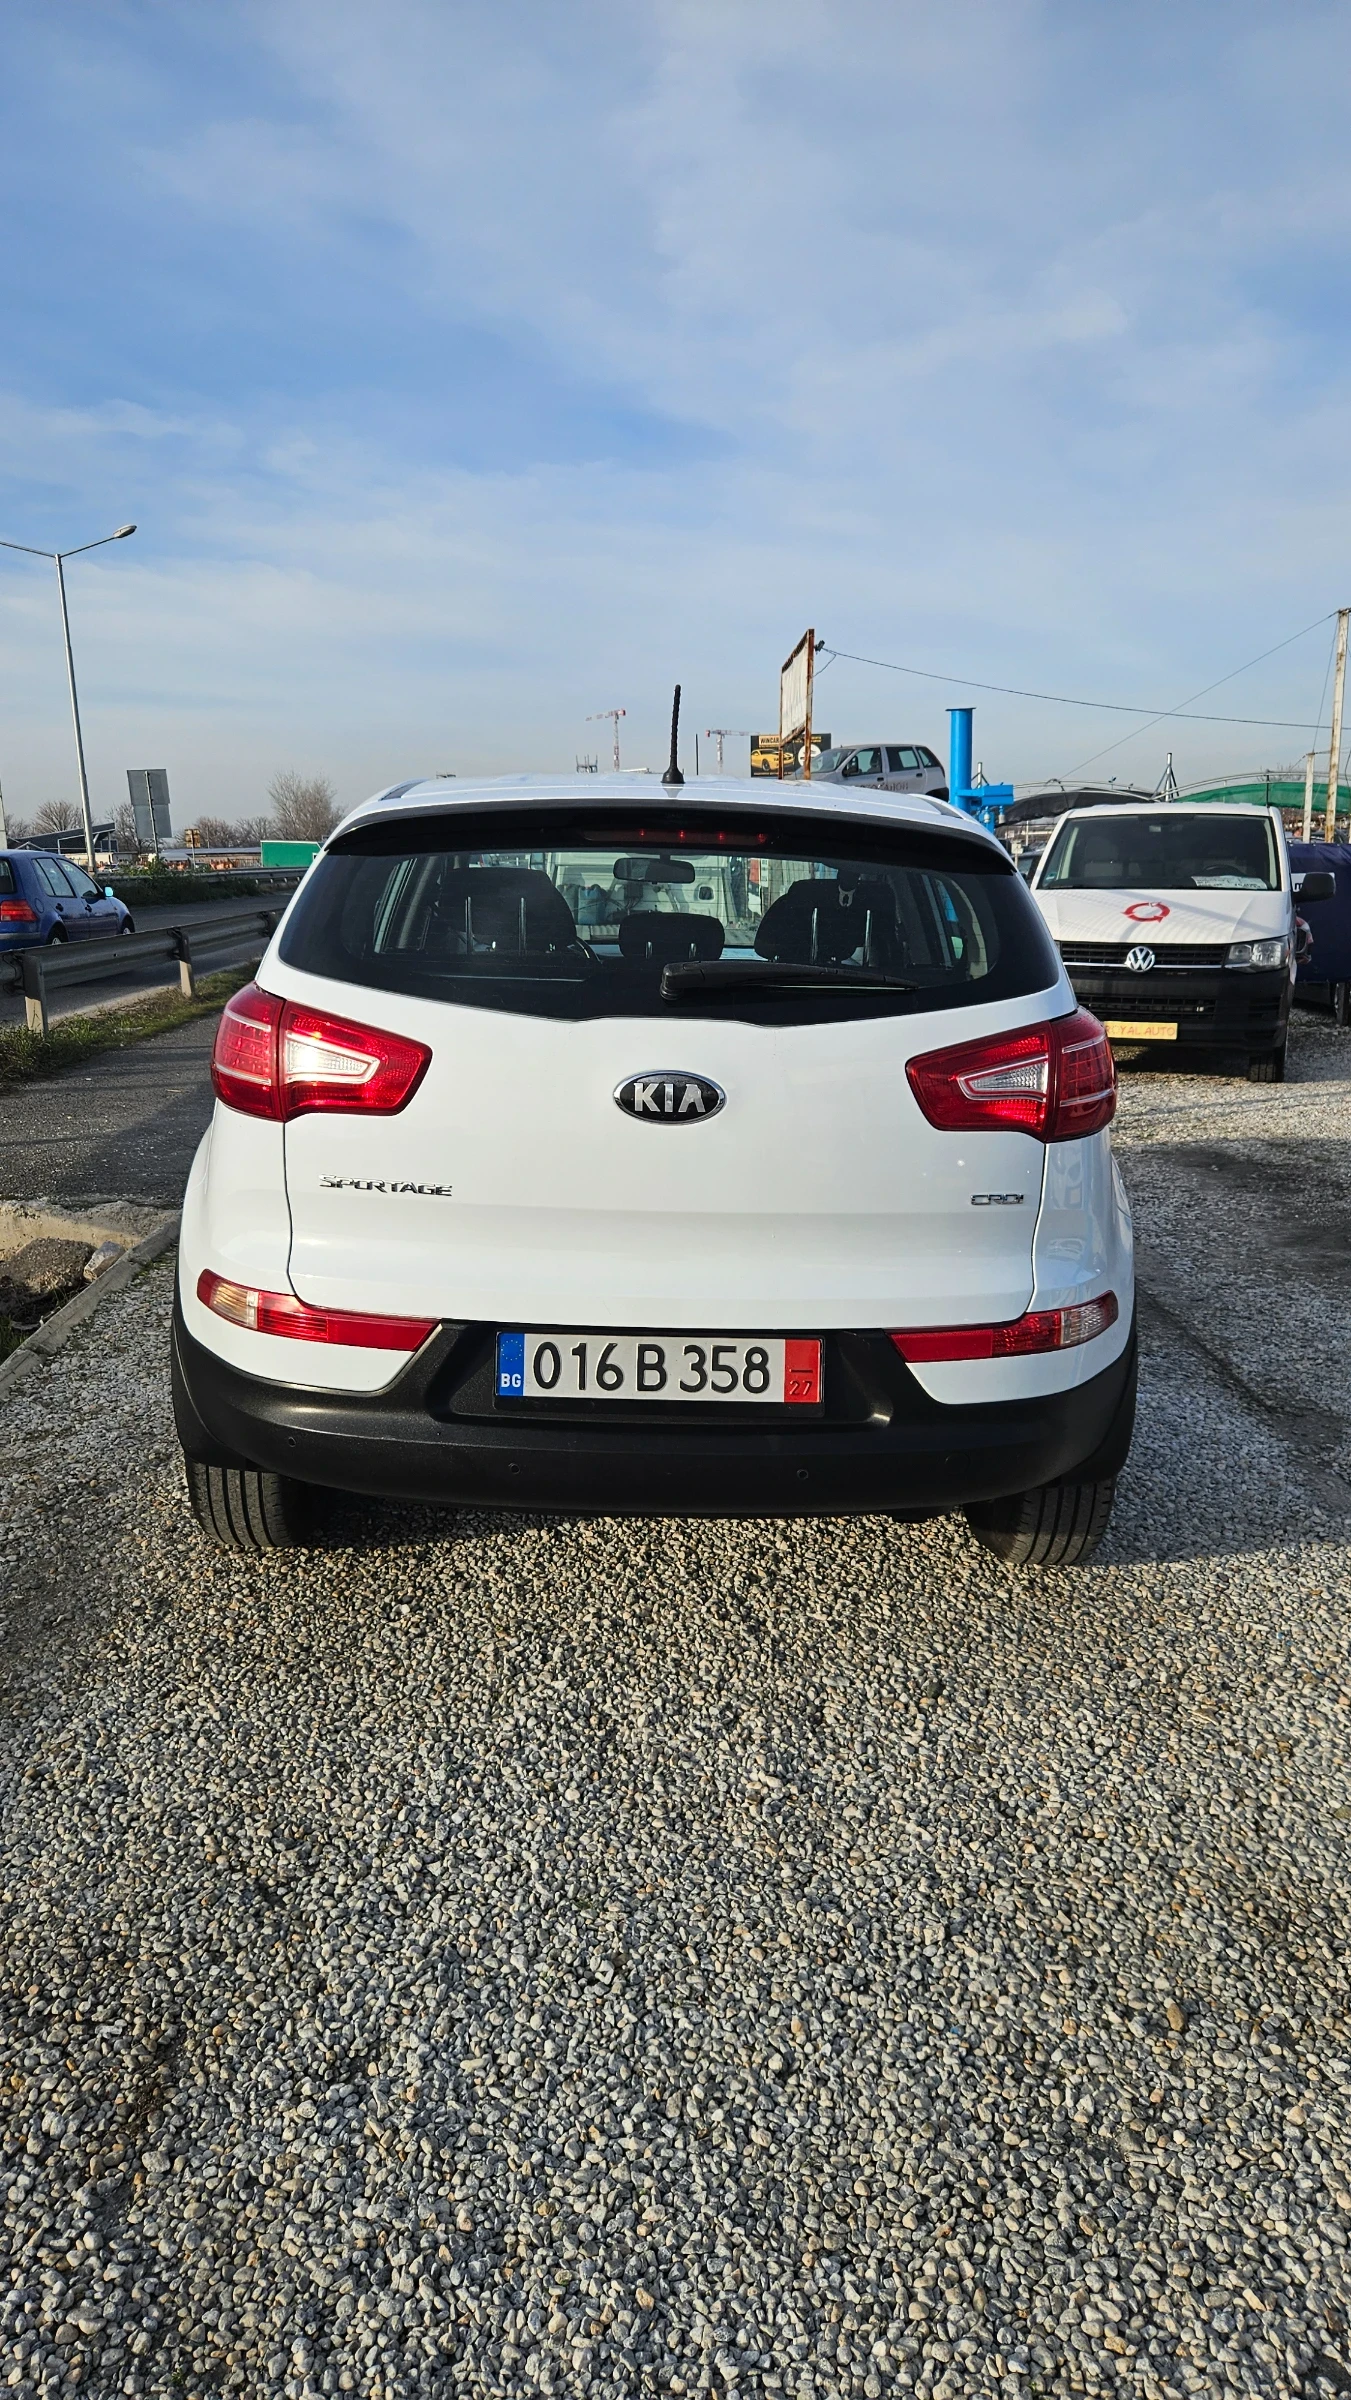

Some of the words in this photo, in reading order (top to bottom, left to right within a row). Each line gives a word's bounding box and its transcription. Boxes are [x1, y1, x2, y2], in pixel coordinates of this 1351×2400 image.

[1105, 1025, 1141, 1035] ROYAL
[1145, 1026, 1175, 1036] AUTO
[633, 1082, 706, 1113] KIA
[318, 1174, 453, 1197] SPORTAGE
[501, 1373, 521, 1388] BG
[789, 1380, 813, 1396] 27
